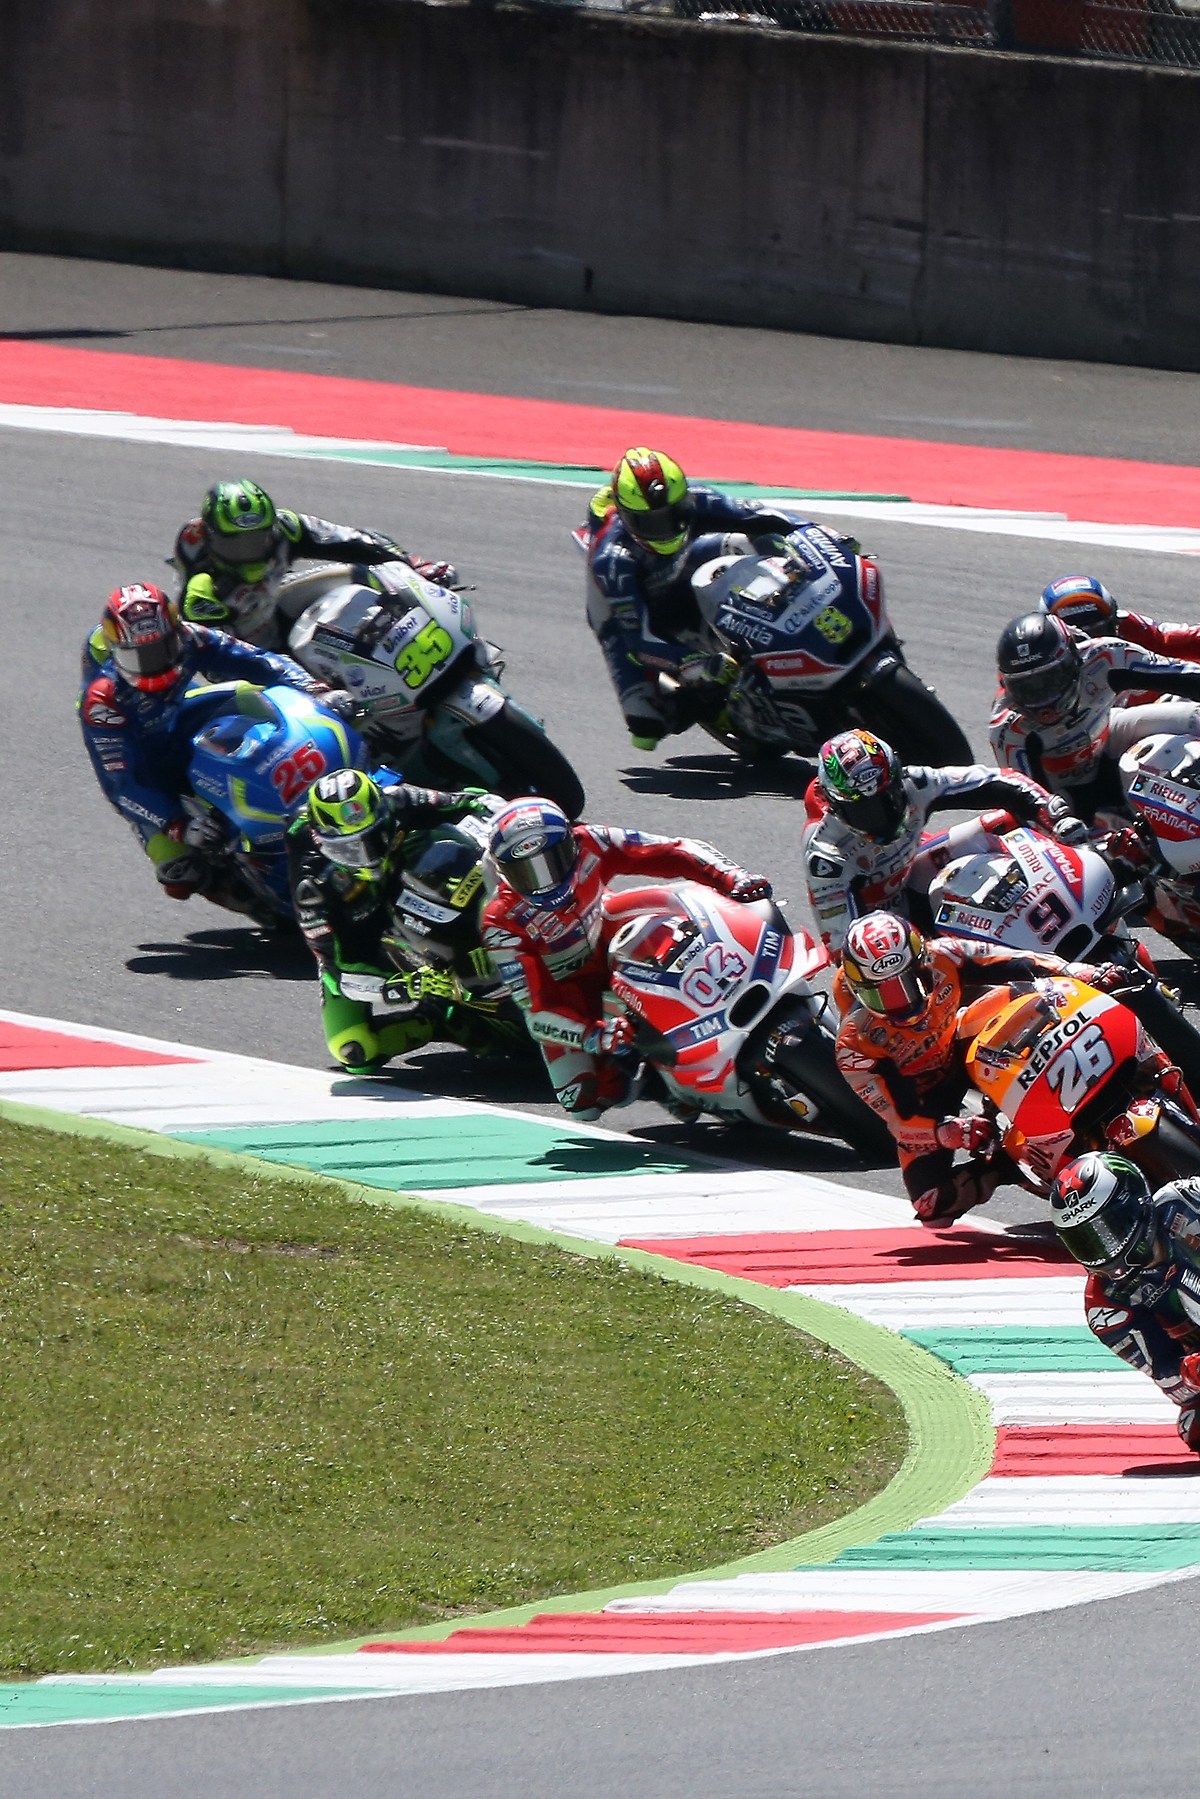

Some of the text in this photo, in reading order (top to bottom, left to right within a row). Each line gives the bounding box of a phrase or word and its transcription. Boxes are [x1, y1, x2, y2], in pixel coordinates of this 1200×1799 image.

[715, 613, 774, 645] Avintia
[394, 619, 454, 690] 35
[272, 743, 327, 809] 25
[1150, 782, 1186, 804] RIELLO
[1143, 805, 1199, 835] PRAMAC
[1019, 844, 1043, 874] RIELLO
[957, 912, 992, 930] RIELLO
[762, 930, 780, 958] TIM
[682, 943, 748, 1008] 04
[874, 954, 902, 973] Arai
[533, 1021, 582, 1043] DUCATI
[690, 1015, 723, 1039] TIM
[1018, 1010, 1092, 1091] REPSOL
[1046, 1023, 1114, 1114] 26
[1061, 1196, 1098, 1223] SHARK
